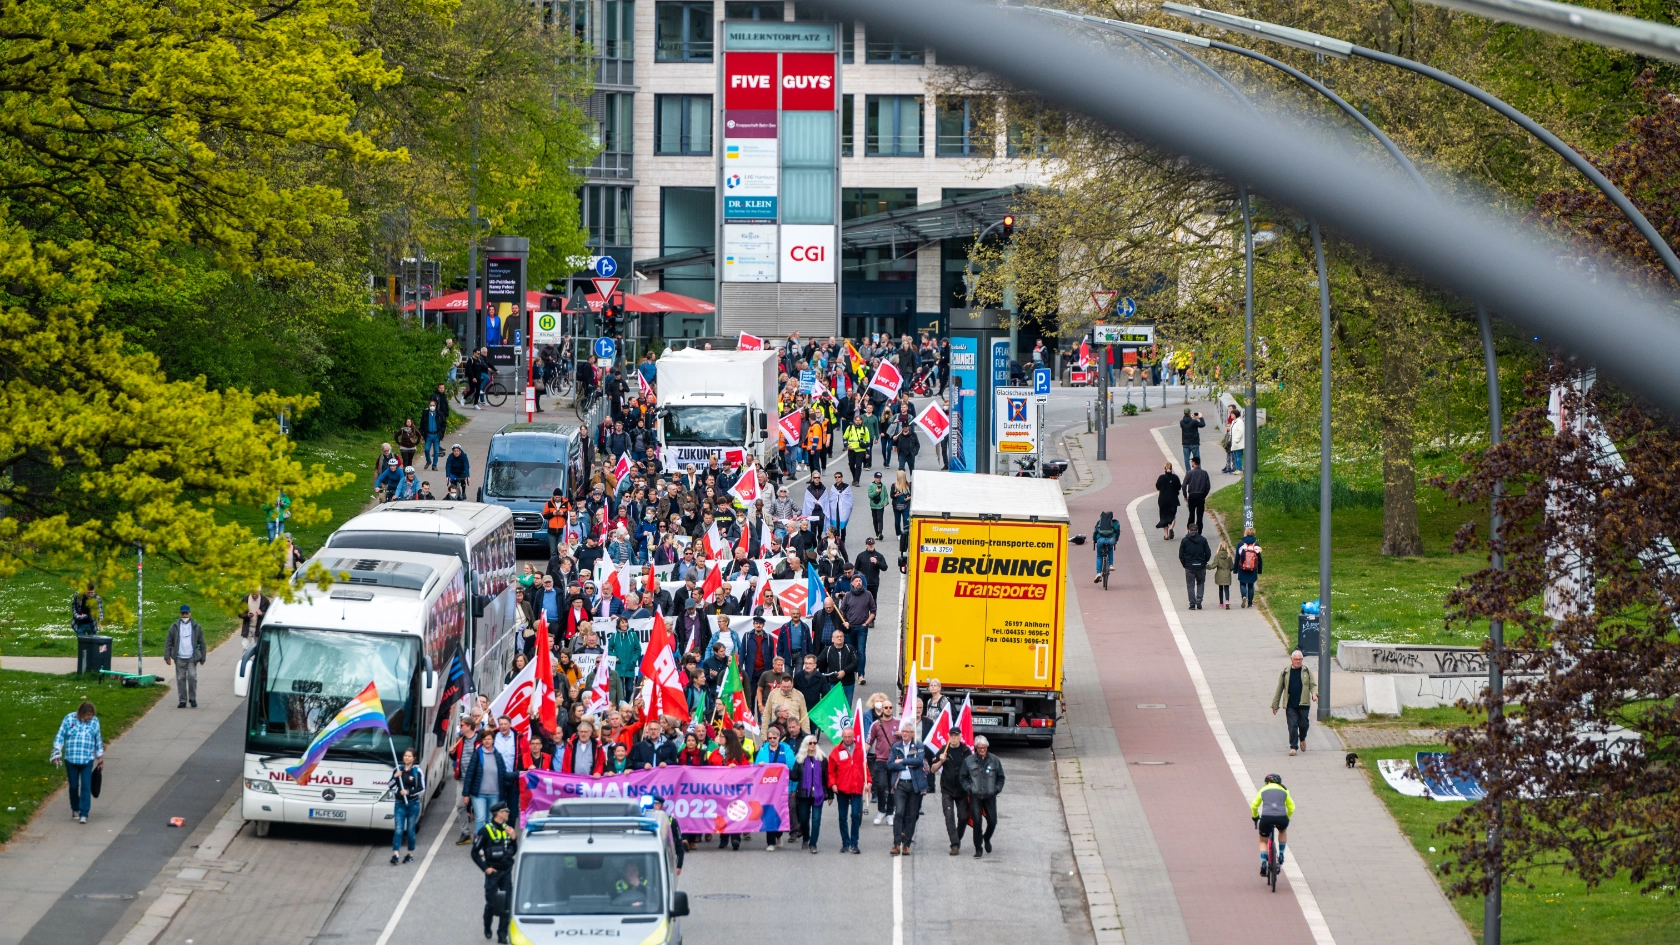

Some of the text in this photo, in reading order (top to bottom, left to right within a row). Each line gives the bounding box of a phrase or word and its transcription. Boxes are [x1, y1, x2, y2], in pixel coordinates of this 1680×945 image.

[730, 33, 820, 41] MILLERNTORPLATZ
[731, 75, 831, 89] FIVE GUYS
[745, 200, 772, 208] KLEIN
[790, 245, 825, 262] CGI
[1036, 372, 1046, 392] P
[1003, 422, 1032, 430] Durchfahrt
[924, 537, 1054, 549] www.bruening-transporte.com
[940, 553, 1053, 577] BRÜNING
[958, 582, 1045, 599] Transporte
[269, 771, 354, 786] NIEHAUS
[763, 776, 778, 784] DGB
[543, 777, 754, 798] 1. GEMAINSAM ZUKUNFT
[664, 798, 718, 819] 2022
[555, 928, 620, 938] POLIZEI
